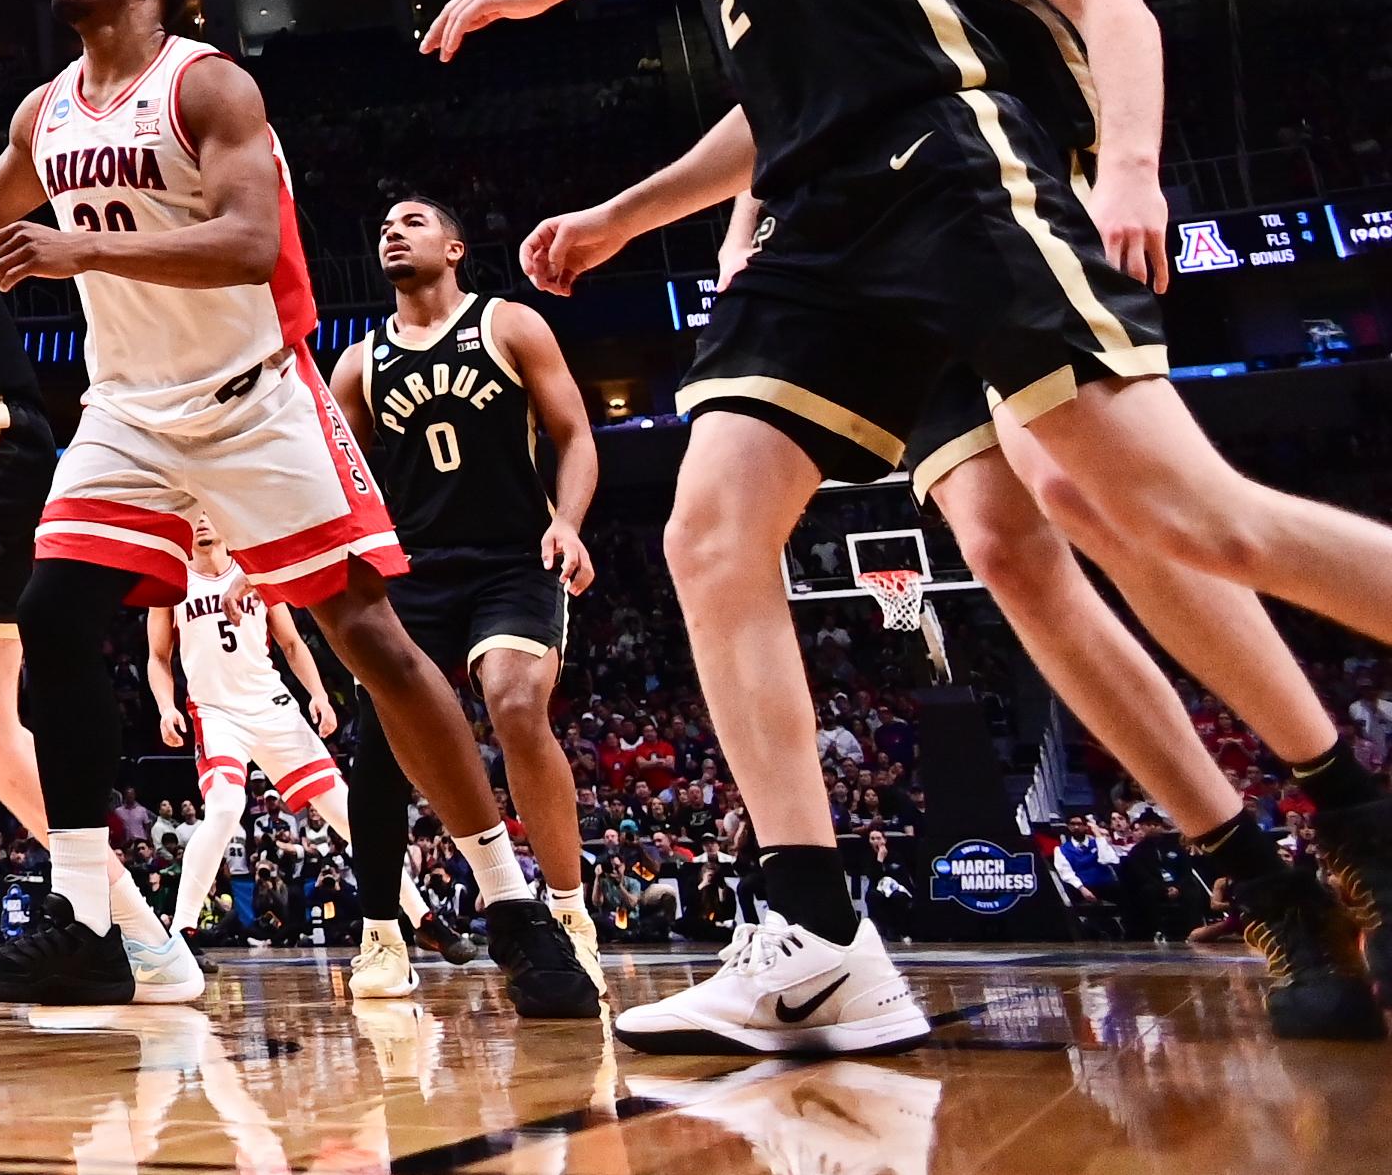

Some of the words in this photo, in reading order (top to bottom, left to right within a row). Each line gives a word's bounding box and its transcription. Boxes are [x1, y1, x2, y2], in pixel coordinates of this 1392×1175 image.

[45, 146, 167, 199] ARIZONA
[1260, 214, 1285, 228] TOL
[1296, 211, 1308, 224] 3
[1266, 232, 1290, 247] FLS
[1250, 248, 1295, 266] BONUS
[687, 313, 712, 327] BON
[381, 363, 503, 435] PURDUE
[425, 422, 461, 473] 0
[185, 594, 256, 623] ARIZNA
[217, 620, 238, 653] 5
[951, 859, 1006, 875] MARCH
[960, 874, 1035, 890] MADNESS
